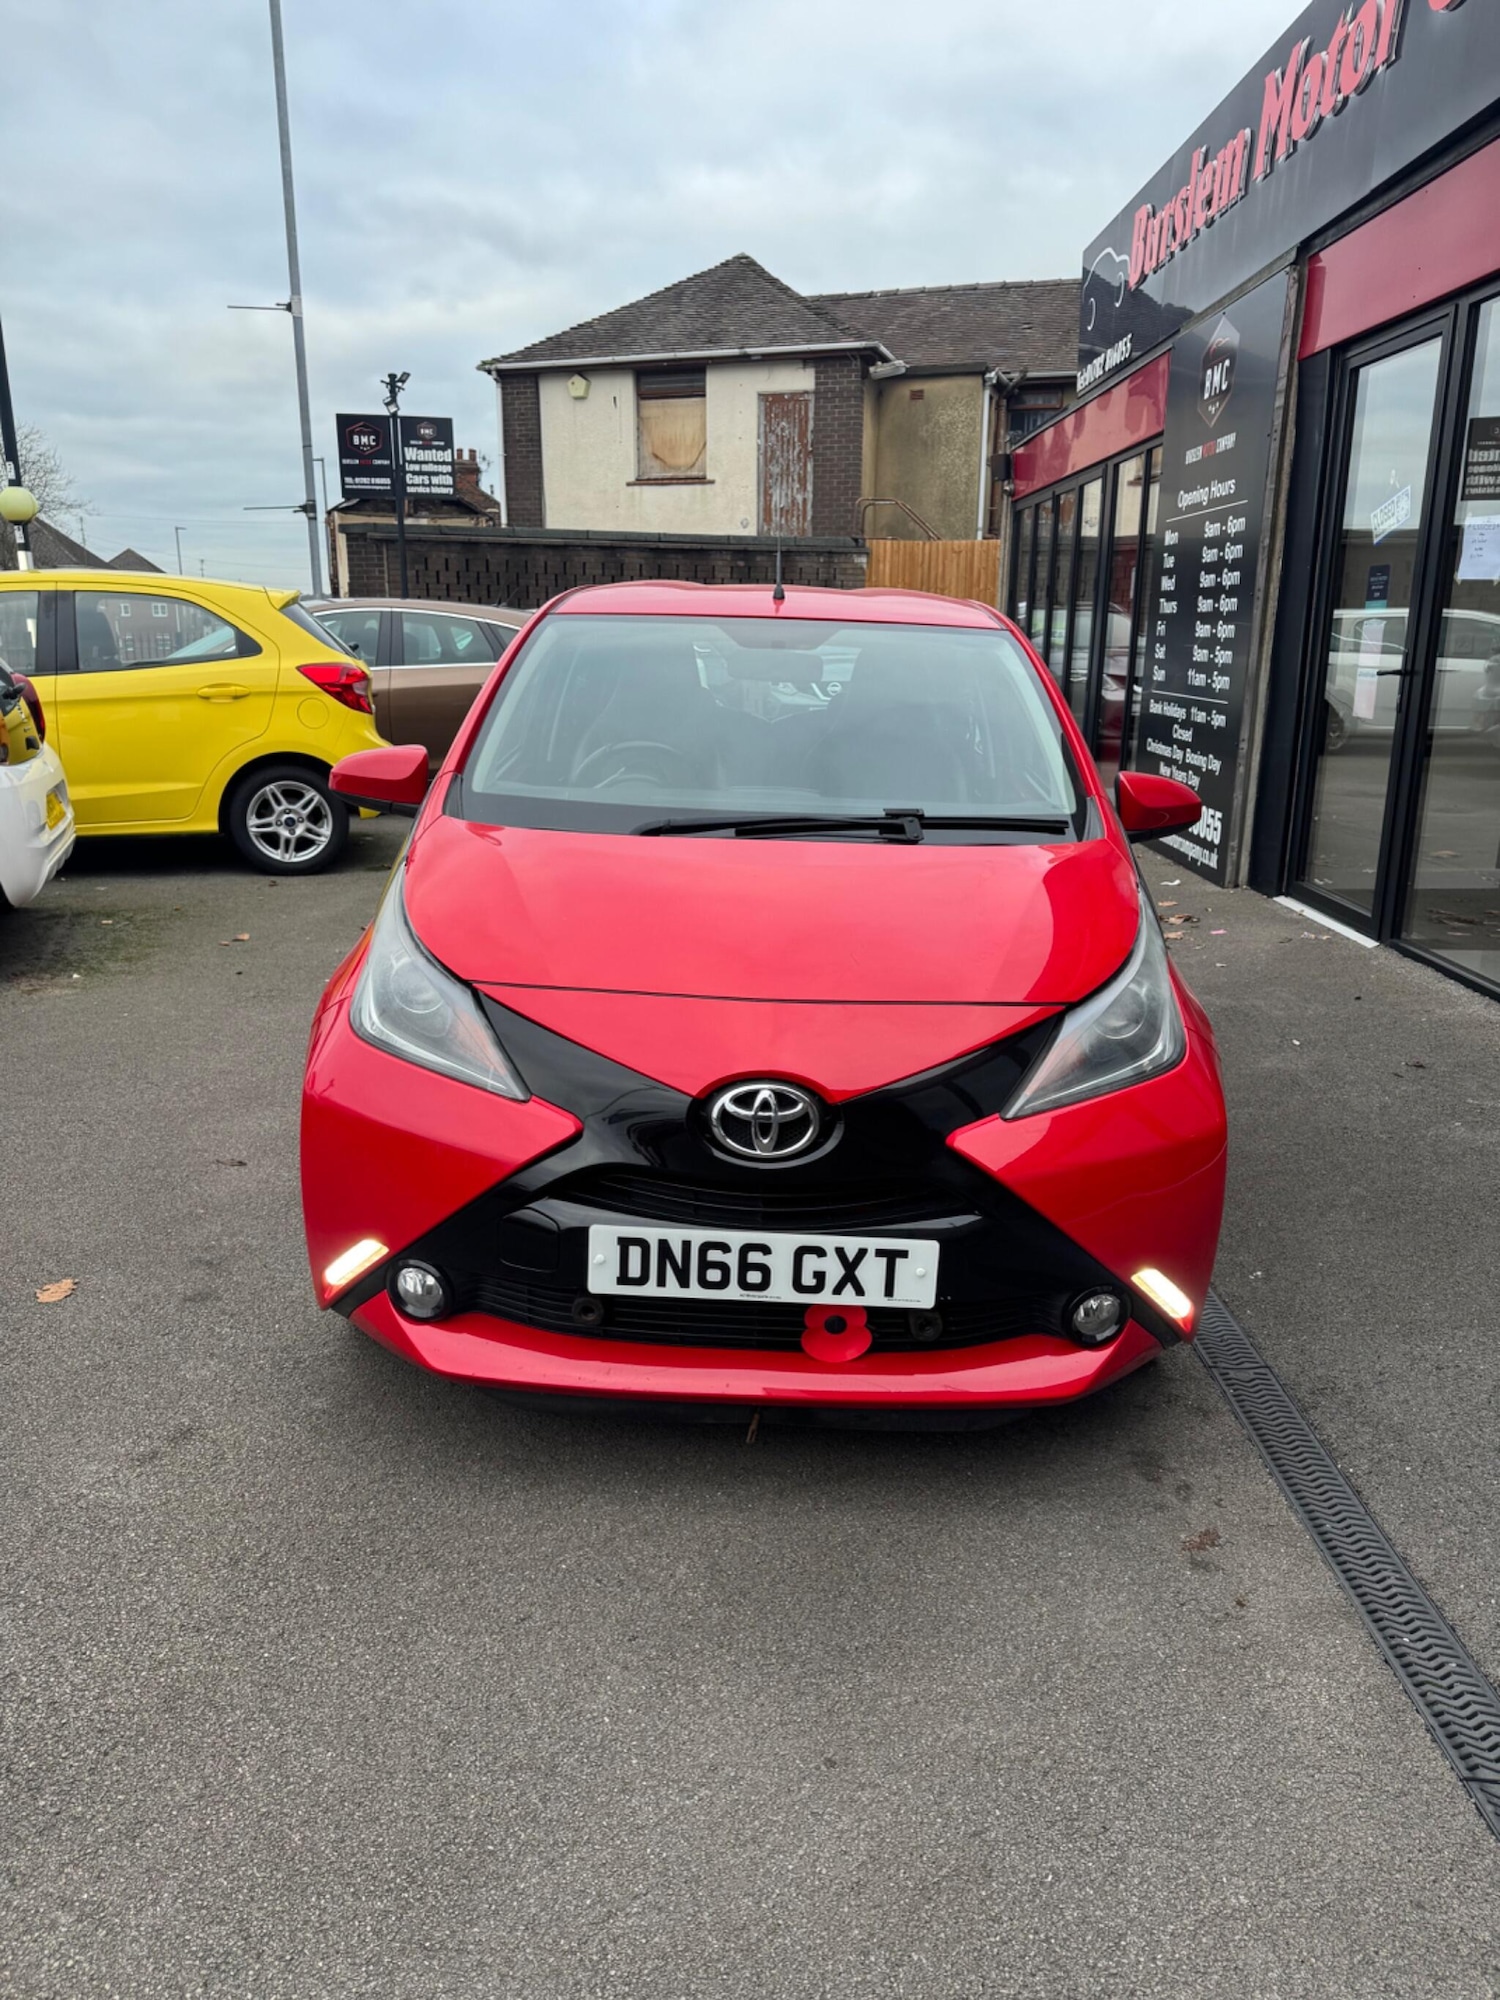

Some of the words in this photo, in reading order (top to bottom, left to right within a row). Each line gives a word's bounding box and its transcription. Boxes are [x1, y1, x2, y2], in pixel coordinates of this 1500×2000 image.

[1129, 128, 1251, 290] Burslem
[1253, 0, 1400, 182] Motor
[1204, 358, 1231, 400] BMC
[353, 435, 376, 446] BMC
[404, 447, 453, 462] Wanted
[405, 462, 420, 472] Low
[421, 463, 452, 474] mileage
[405, 473, 430, 485] Cars
[431, 475, 453, 486] with
[1177, 484, 1209, 511] Opening
[1209, 479, 1236, 499] Hours
[1164, 529, 1178, 546] Mon
[1204, 521, 1221, 538] 9am
[1227, 515, 1246, 537] 6pm
[1163, 553, 1175, 568] Tue
[1201, 545, 1218, 563] 9am
[1224, 542, 1243, 564] 6pm
[1161, 574, 1176, 591] Wed
[1199, 570, 1216, 588] 9am
[1222, 568, 1240, 590] 6pm
[1159, 598, 1178, 614] Thurs
[1197, 595, 1213, 613] 9am
[1219, 593, 1238, 616] 6pm
[1156, 620, 1166, 636] Fri
[1195, 620, 1211, 637] 9am
[1217, 620, 1235, 642] 6pm
[1155, 643, 1166, 659] Sat
[1192, 644, 1209, 662] 9am
[1214, 645, 1233, 668] 5pm
[1153, 665, 1166, 681] Sun
[1187, 668, 1206, 686] 11am
[1212, 671, 1231, 693] 5pm
[1149, 699, 1163, 715] Bank
[1163, 701, 1186, 722] Holidays
[1191, 706, 1207, 723] 11am
[1211, 710, 1226, 730] 5pm
[1172, 724, 1193, 742] Closed
[1146, 738, 1172, 758] Christmas
[1172, 744, 1184, 764] Day
[1185, 748, 1208, 772] Boxing
[1208, 754, 1222, 776] Day
[1159, 761, 1171, 777] New
[1171, 764, 1188, 783] Years
[1187, 770, 1200, 791] Day
[616, 1236, 772, 1292] DN66
[792, 1244, 910, 1298] GXT
